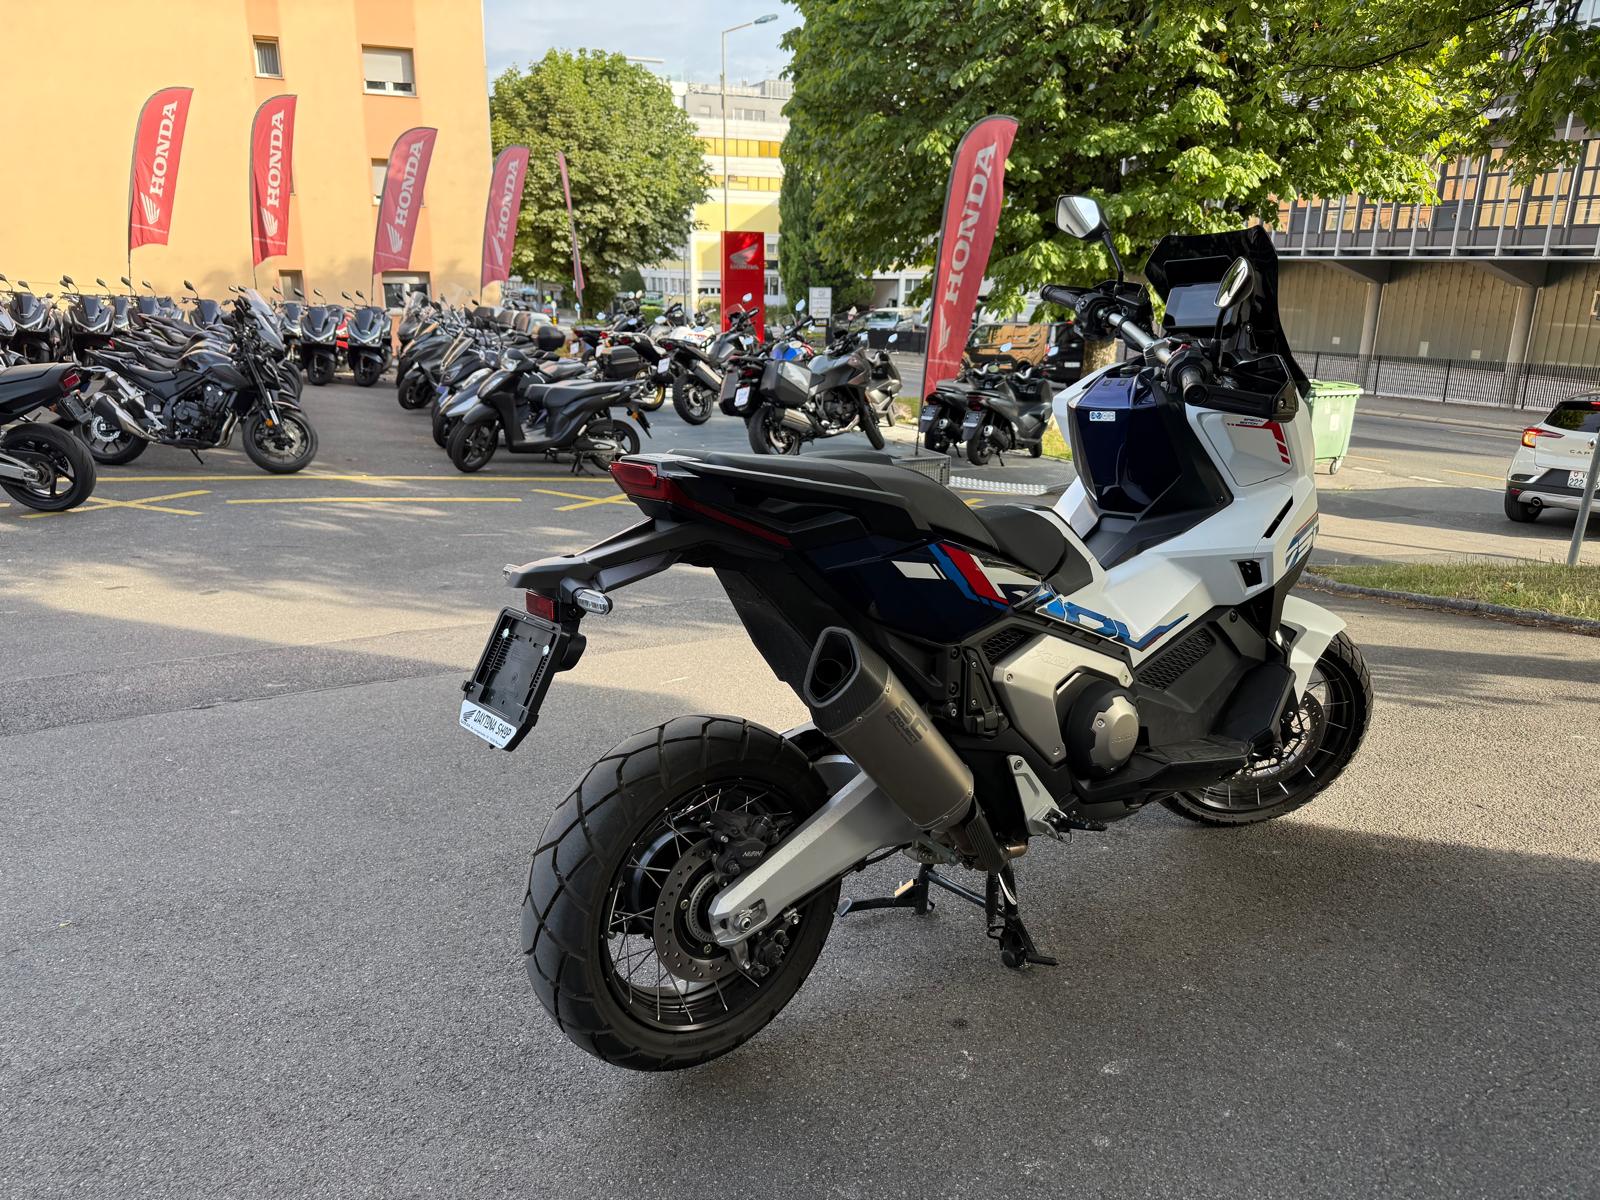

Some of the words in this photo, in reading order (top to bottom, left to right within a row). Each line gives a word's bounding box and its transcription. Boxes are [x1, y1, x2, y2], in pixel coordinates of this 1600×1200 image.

[149, 101, 178, 196] HONDA
[266, 109, 285, 208] HONDA
[393, 140, 425, 228] HONDA
[497, 158, 520, 242] HONDA
[944, 141, 998, 306] HONDA
[473, 710, 497, 731] DAYTONA
[495, 723, 512, 739] SHOP
